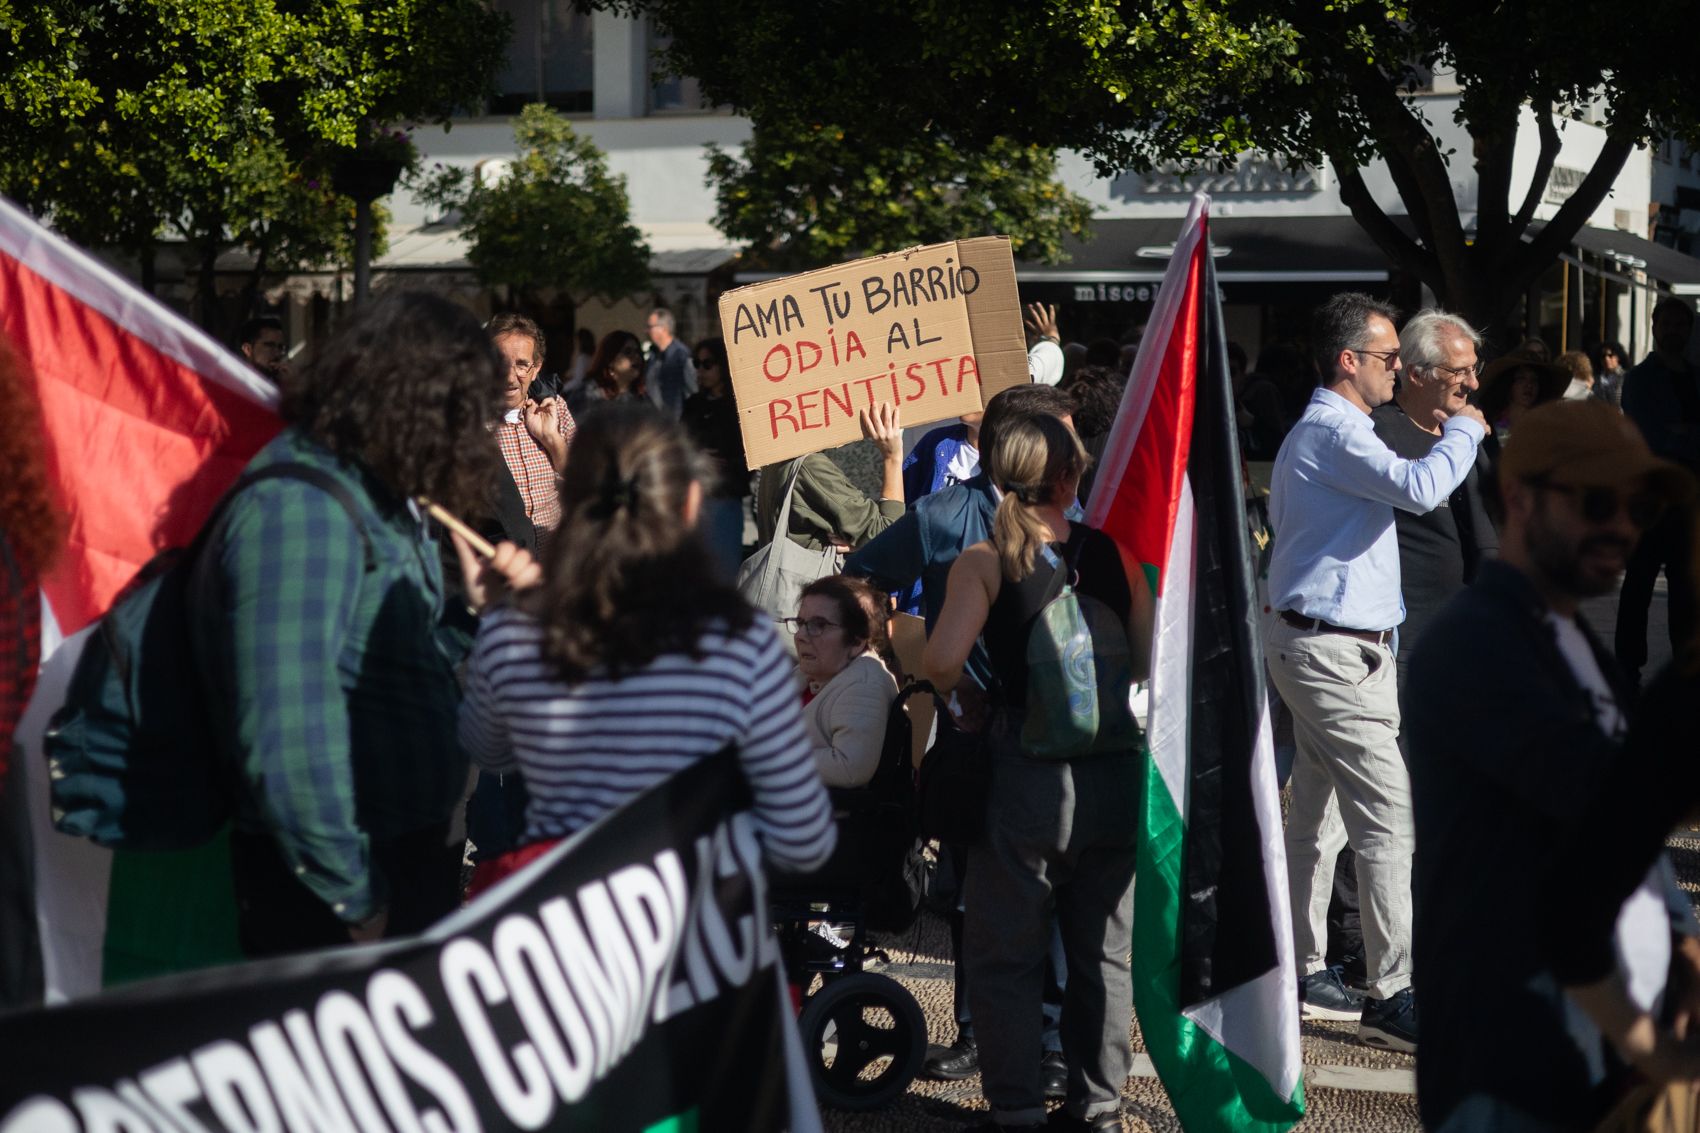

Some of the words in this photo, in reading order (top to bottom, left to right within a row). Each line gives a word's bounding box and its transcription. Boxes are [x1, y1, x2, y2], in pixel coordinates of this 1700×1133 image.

[733, 294, 805, 345] AMA
[809, 281, 851, 325] TU
[887, 317, 942, 354] AL
